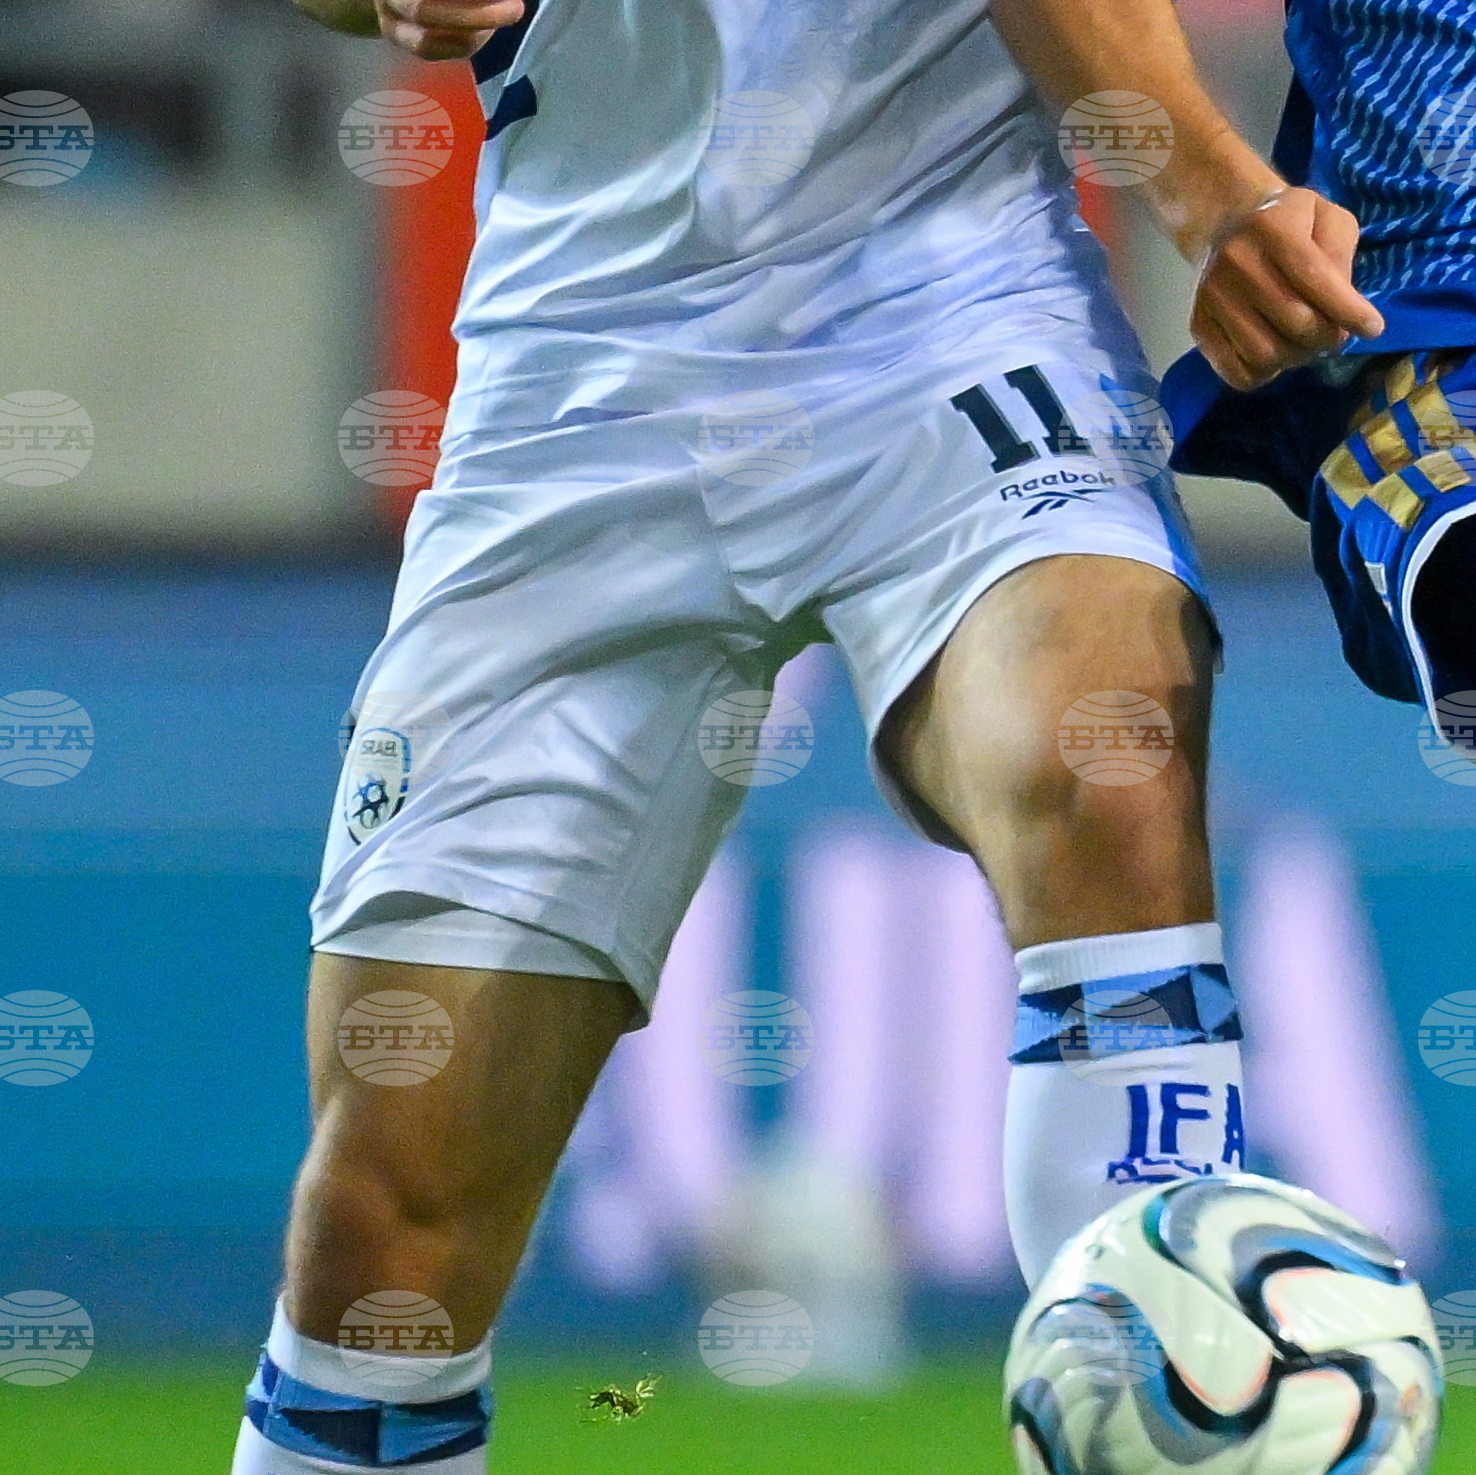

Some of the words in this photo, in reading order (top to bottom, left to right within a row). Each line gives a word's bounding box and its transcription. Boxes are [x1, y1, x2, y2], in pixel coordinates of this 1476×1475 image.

[949, 364, 1096, 474] 11
[1000, 470, 1115, 501] Reebok
[1126, 1082, 1246, 1171] IFA
